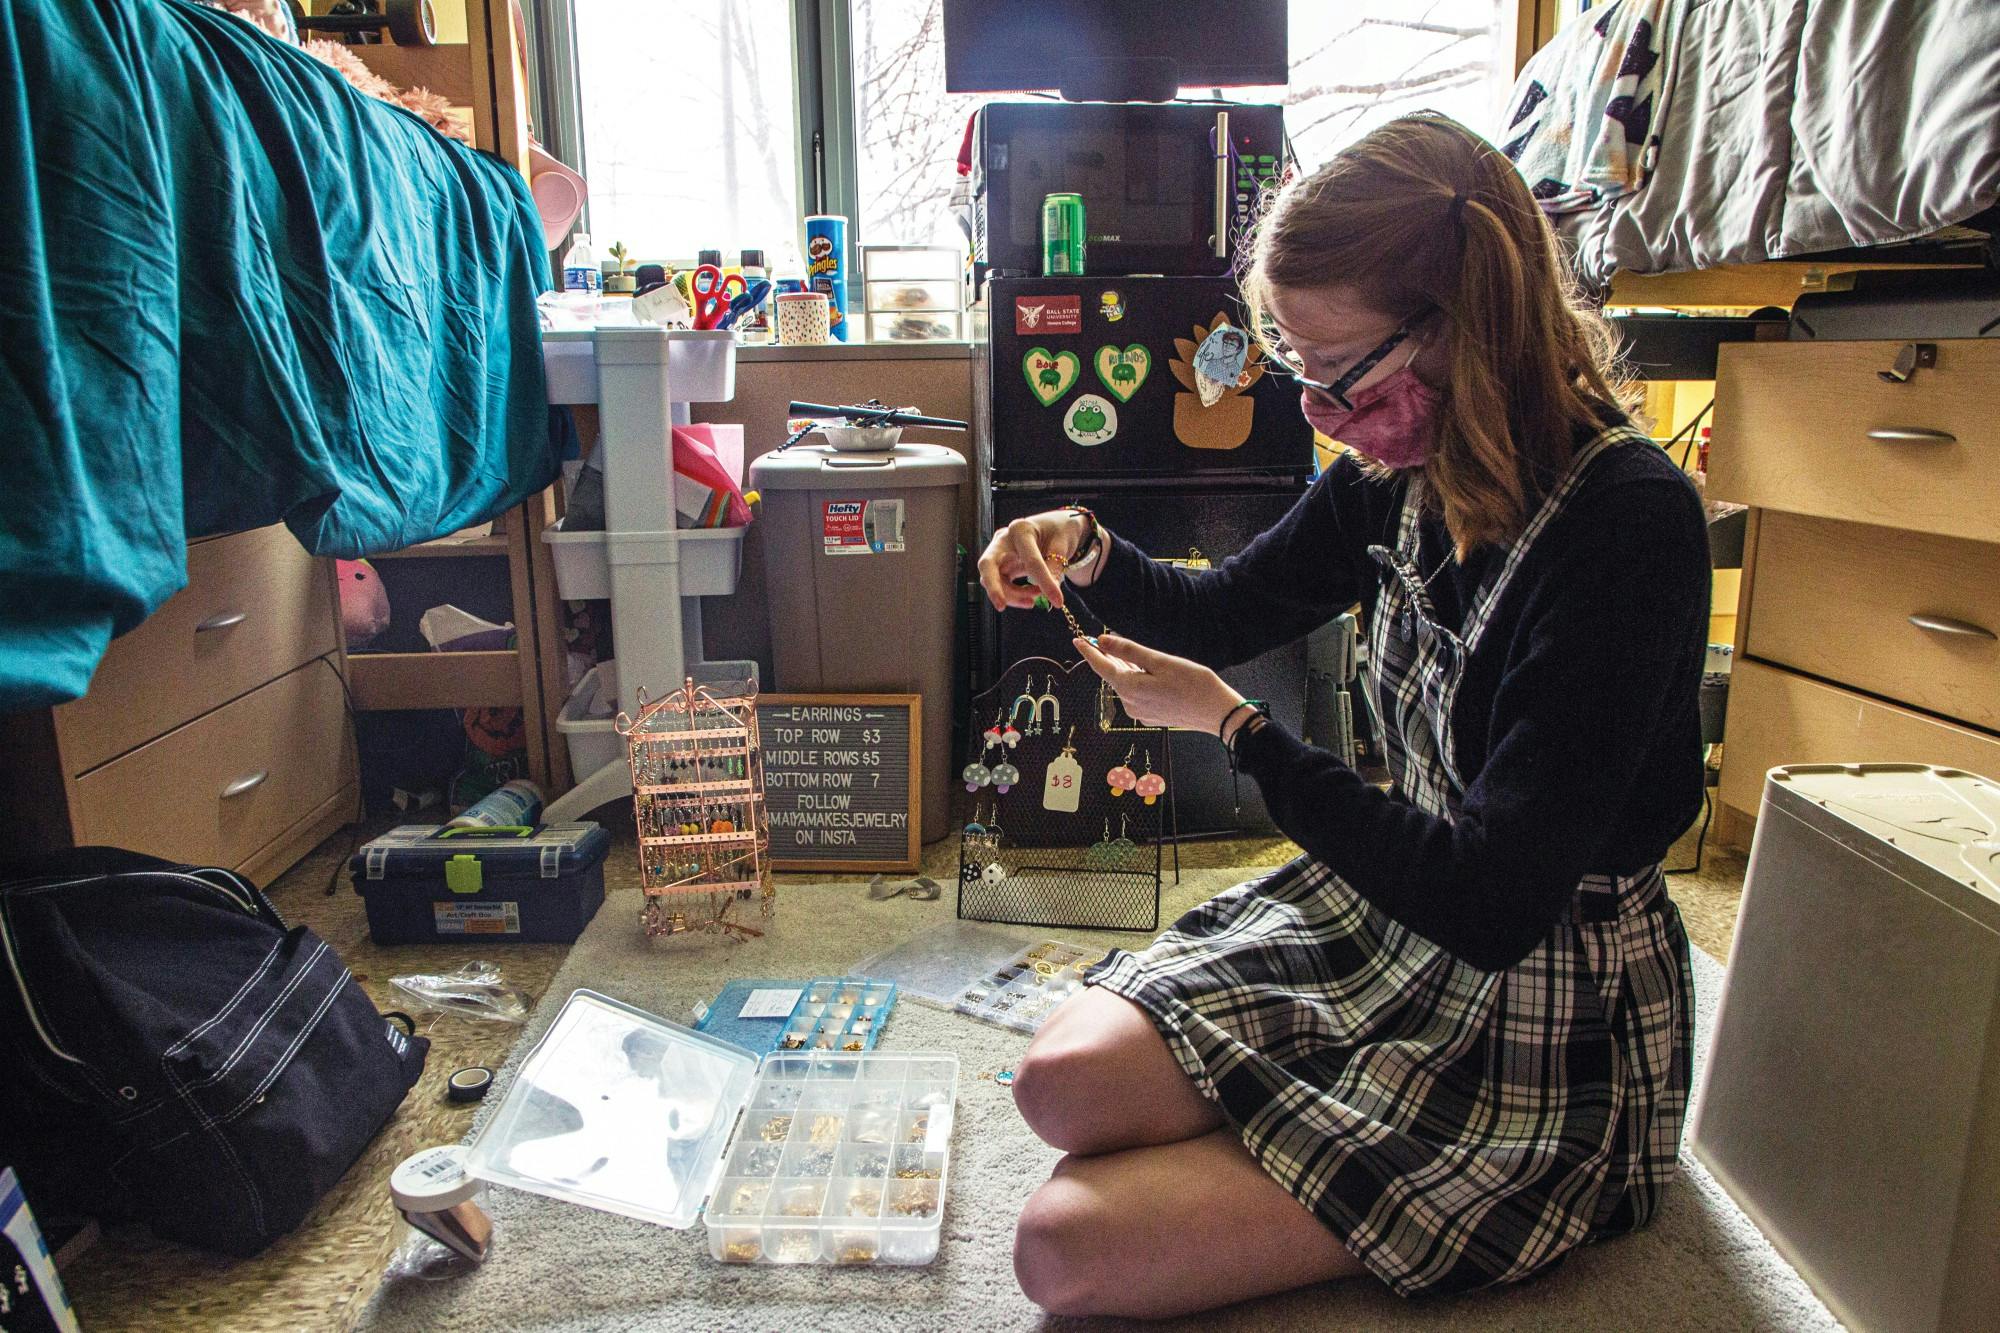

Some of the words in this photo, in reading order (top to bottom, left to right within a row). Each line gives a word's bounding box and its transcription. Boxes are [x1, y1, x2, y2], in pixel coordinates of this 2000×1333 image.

[829, 504, 860, 514] Hefty
[791, 707, 862, 722] EARRINGS
[774, 728, 804, 744] TOP
[811, 728, 841, 744] ROW
[862, 729, 881, 745] $3
[765, 751, 818, 766] MIDDLE
[823, 751, 859, 766] ROWS
[862, 751, 880, 767] $5
[765, 772, 819, 788] BOTTOM
[823, 773, 852, 788] ROW
[871, 773, 880, 789] 7
[1051, 775, 1073, 788] $8
[797, 795, 851, 810] FOLLOW
[767, 812, 907, 828] MAIYAMAKESJEWELRY
[795, 830, 814, 845] ON
[820, 830, 857, 845] INSTA
